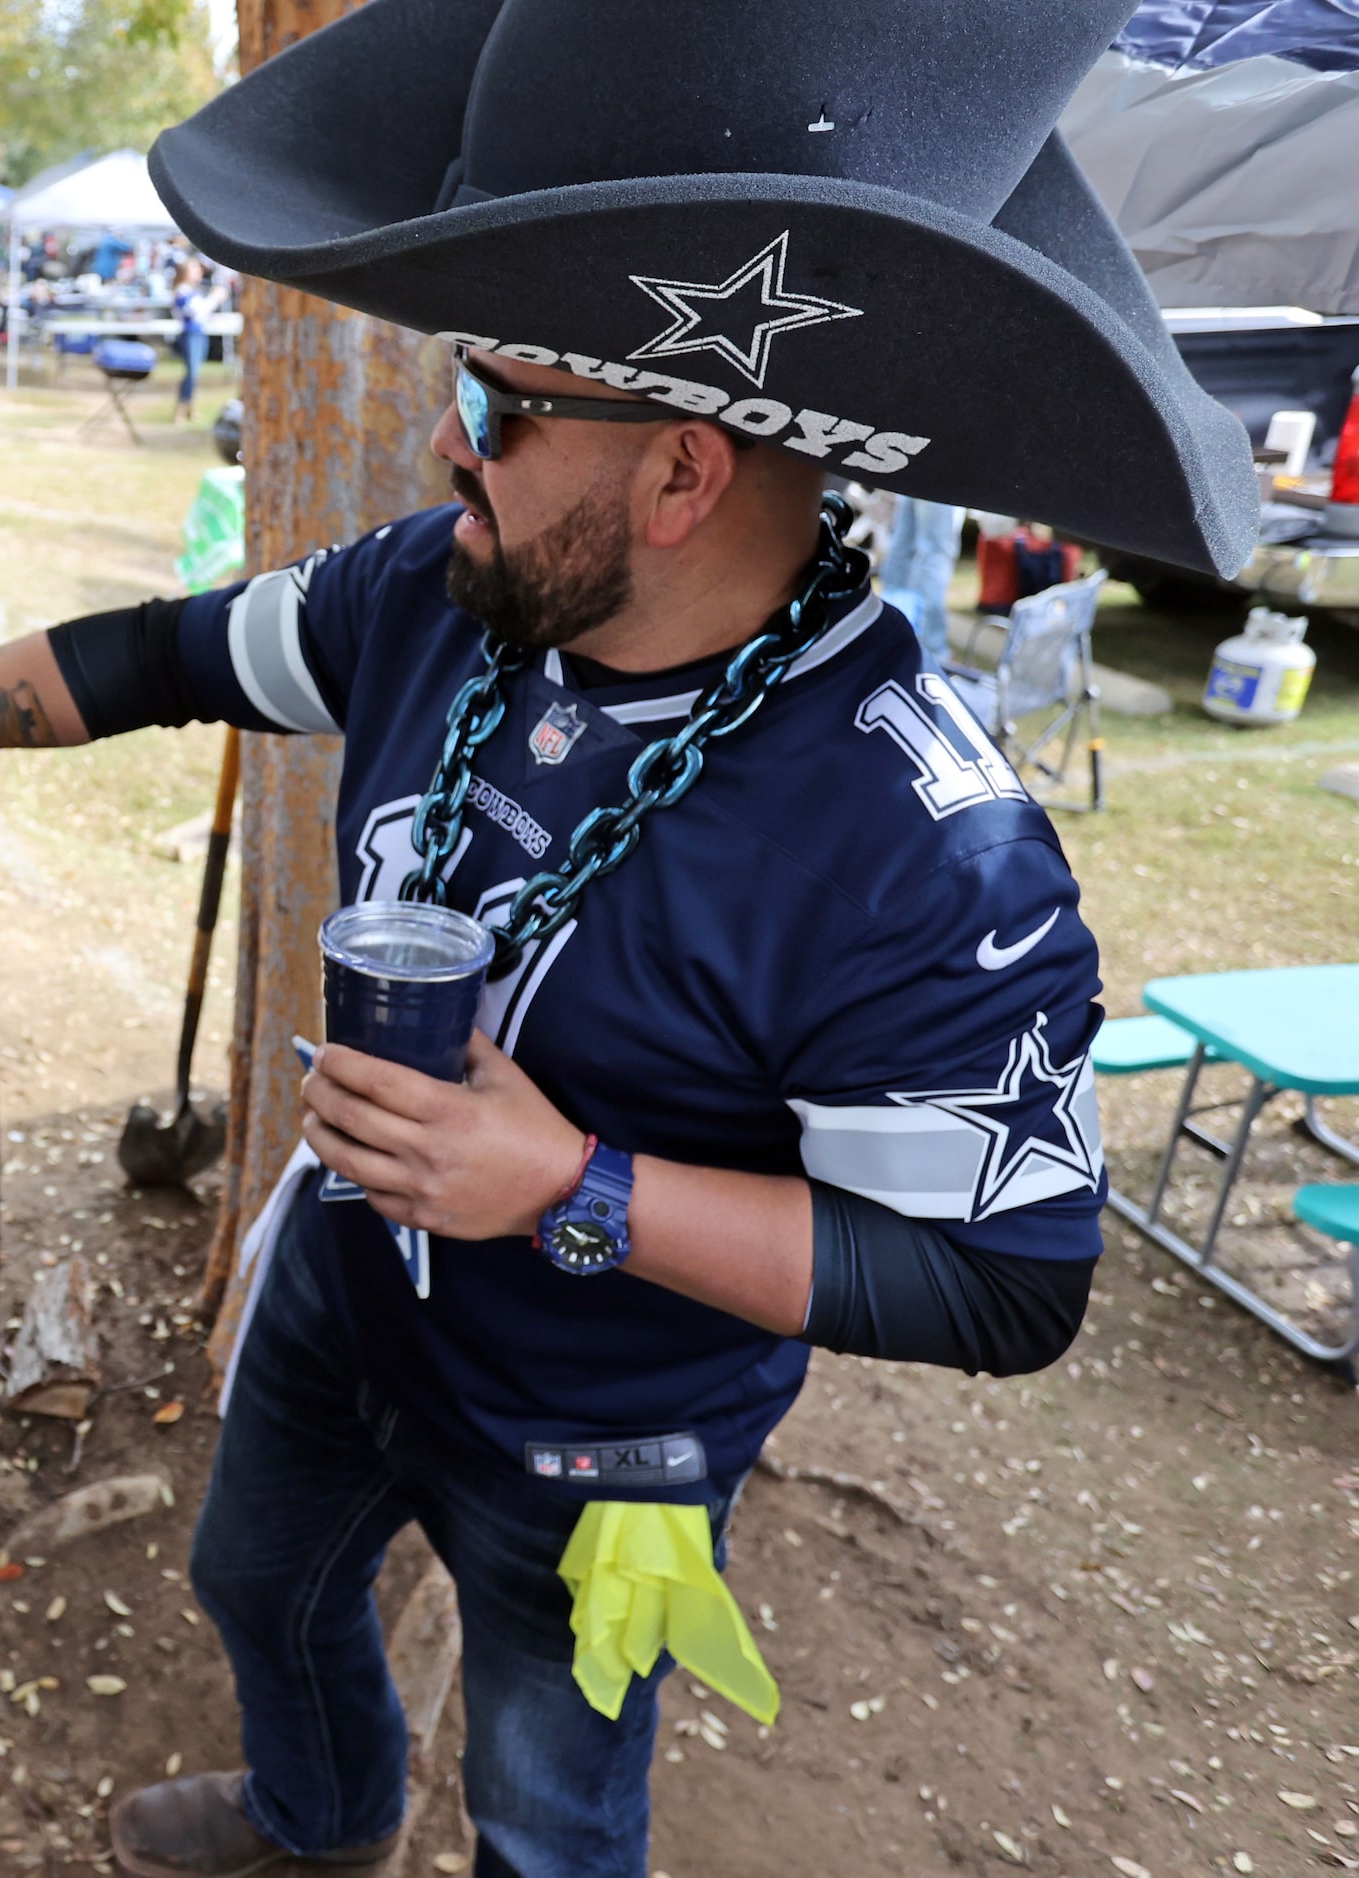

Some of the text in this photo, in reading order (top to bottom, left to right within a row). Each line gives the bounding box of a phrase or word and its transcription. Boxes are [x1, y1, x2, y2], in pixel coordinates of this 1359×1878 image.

[535, 722, 564, 756] NFL
[854, 673, 1028, 821] 11
[466, 775, 553, 859] COWBOYS
[614, 1448, 650, 1468] XL
